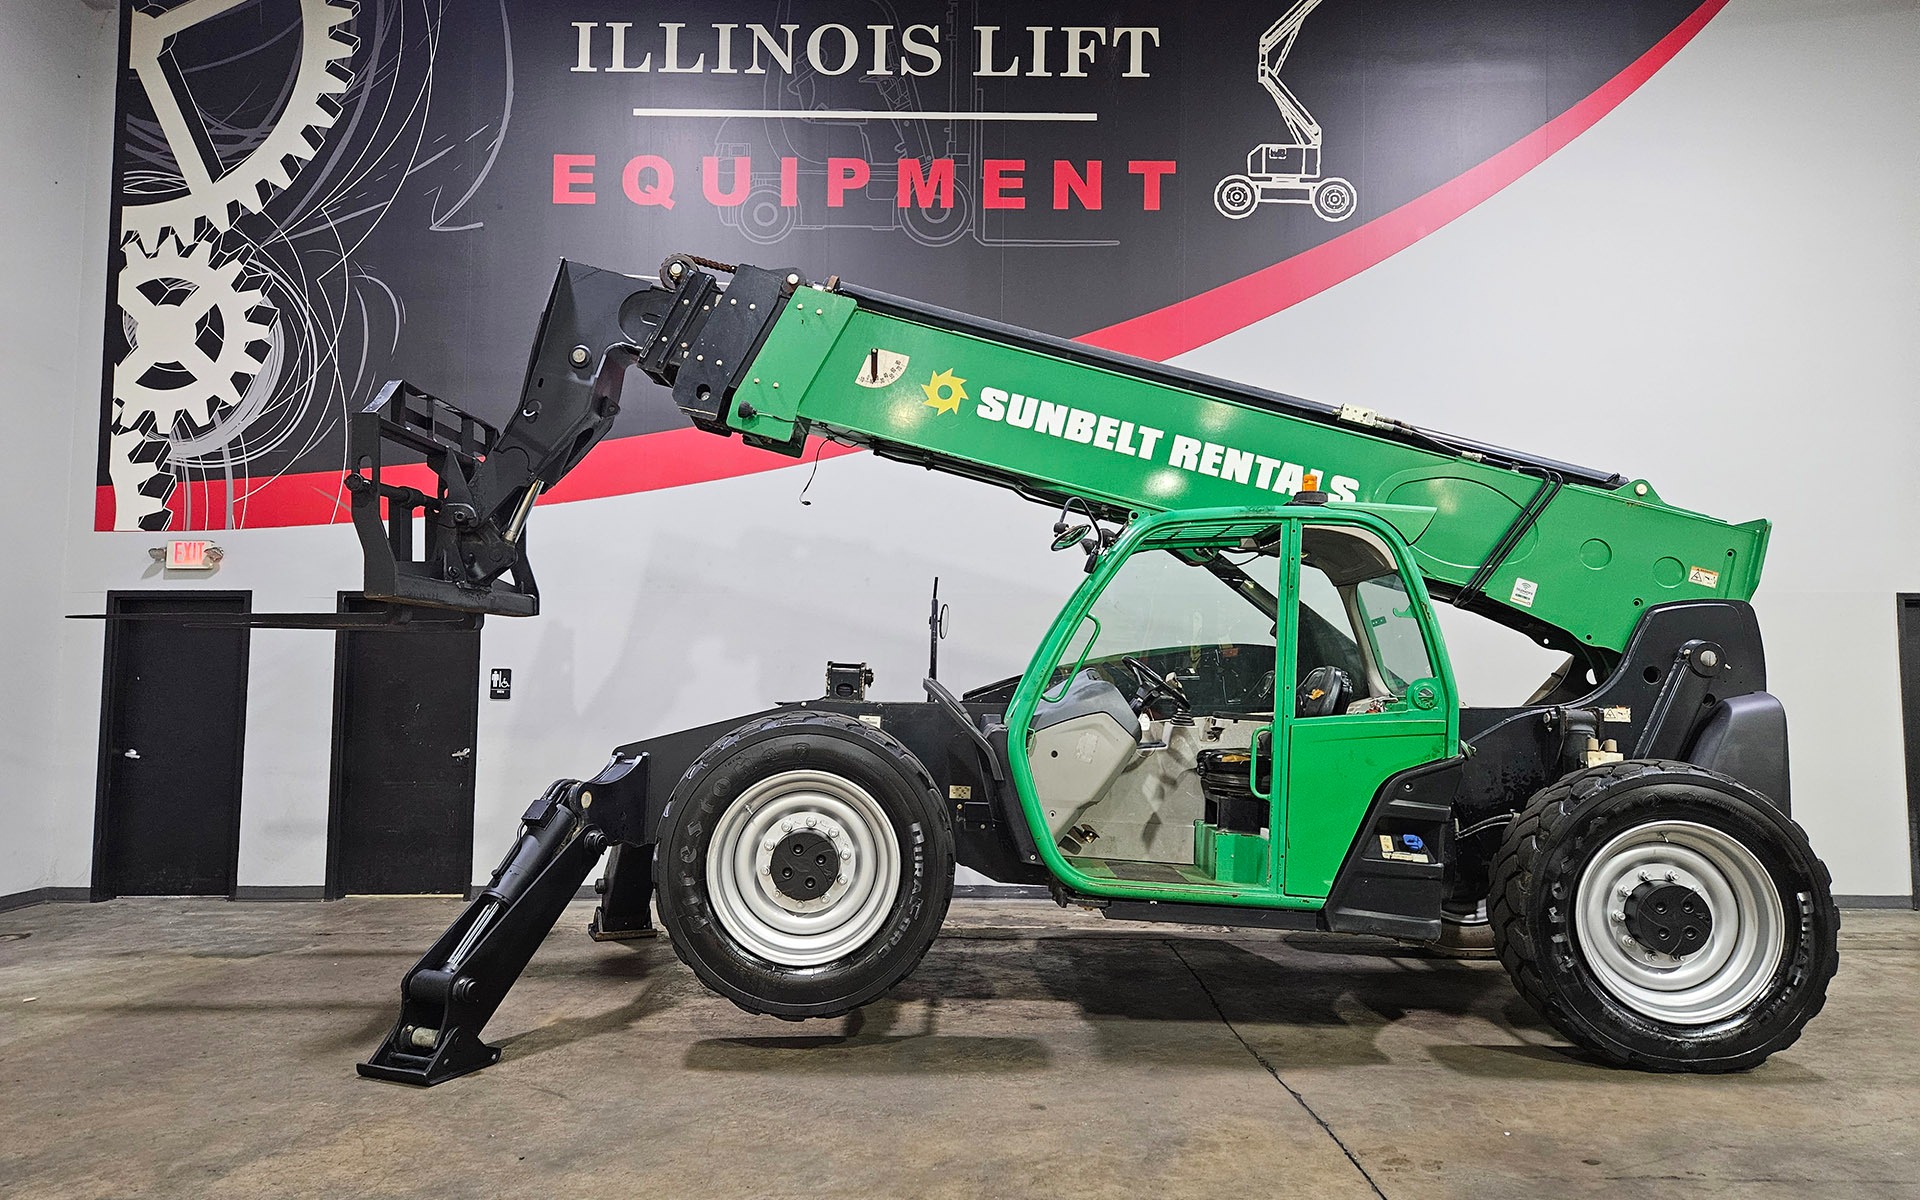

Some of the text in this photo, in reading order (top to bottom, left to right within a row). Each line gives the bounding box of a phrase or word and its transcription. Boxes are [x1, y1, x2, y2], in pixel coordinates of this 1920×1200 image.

[570, 22, 1160, 77] ILLINOIS LIFT
[553, 154, 1176, 210] EQUIPMENT
[976, 386, 1165, 460] SUNBELT
[174, 542, 205, 564] EXIT
